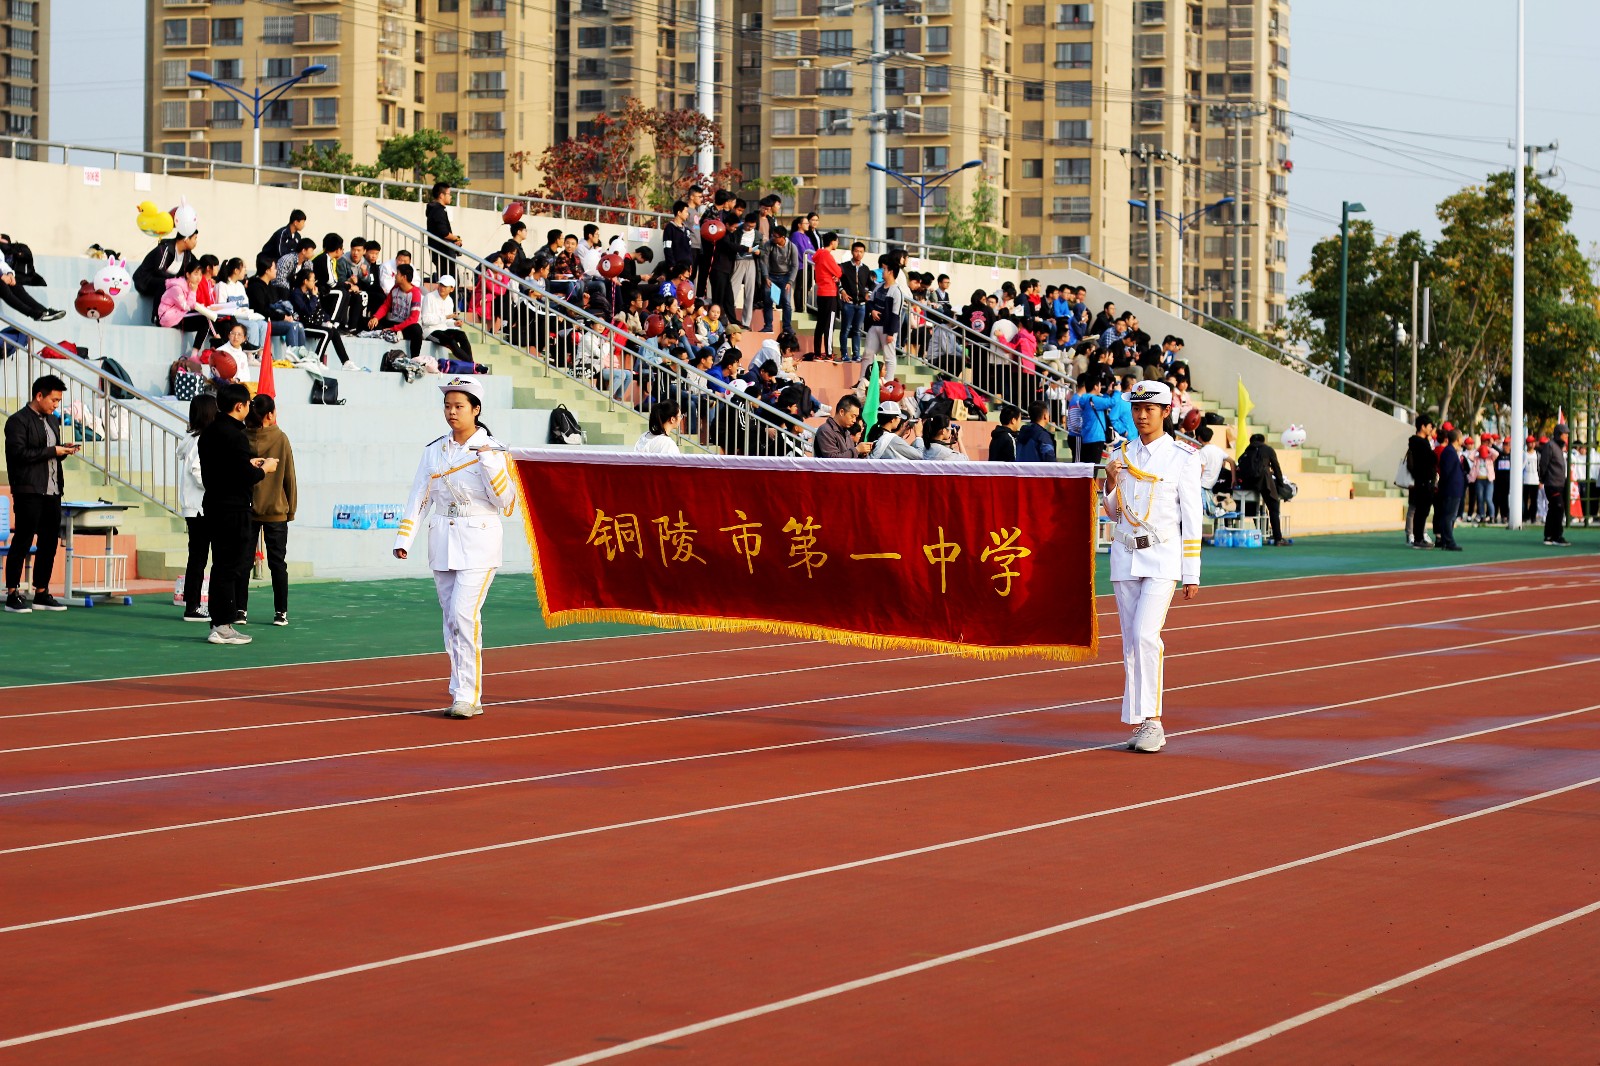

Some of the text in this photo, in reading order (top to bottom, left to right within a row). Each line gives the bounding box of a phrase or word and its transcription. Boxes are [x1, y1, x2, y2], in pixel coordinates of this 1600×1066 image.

[585, 508, 1032, 597] 铜陵市第一中学
